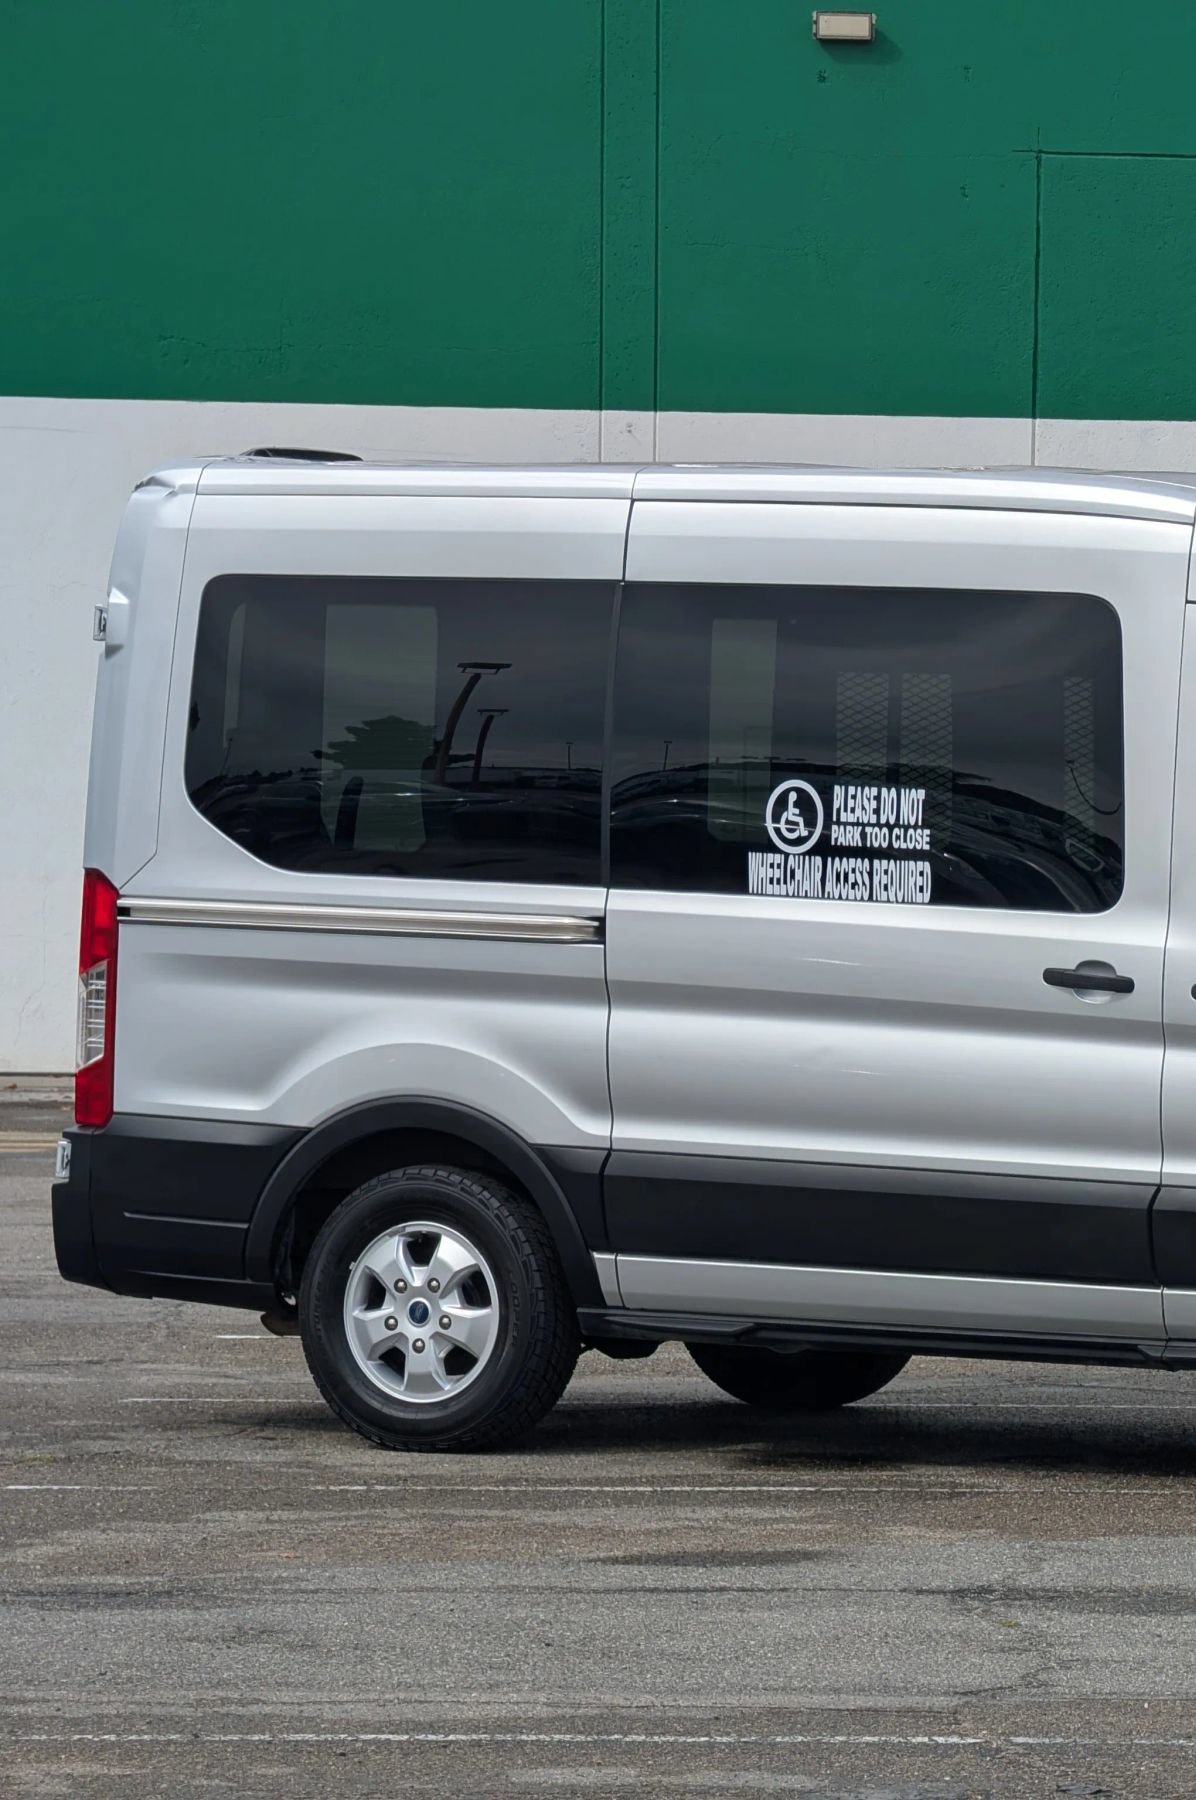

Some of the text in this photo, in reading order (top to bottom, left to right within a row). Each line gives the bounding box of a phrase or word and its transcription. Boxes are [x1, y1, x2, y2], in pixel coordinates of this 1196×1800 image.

[832, 785, 926, 826] PLEASE DO NOT
[831, 825, 931, 850] PARK TOO CLOSE
[748, 851, 932, 904] WHEELCHAIR ACCESS REQUIRED
